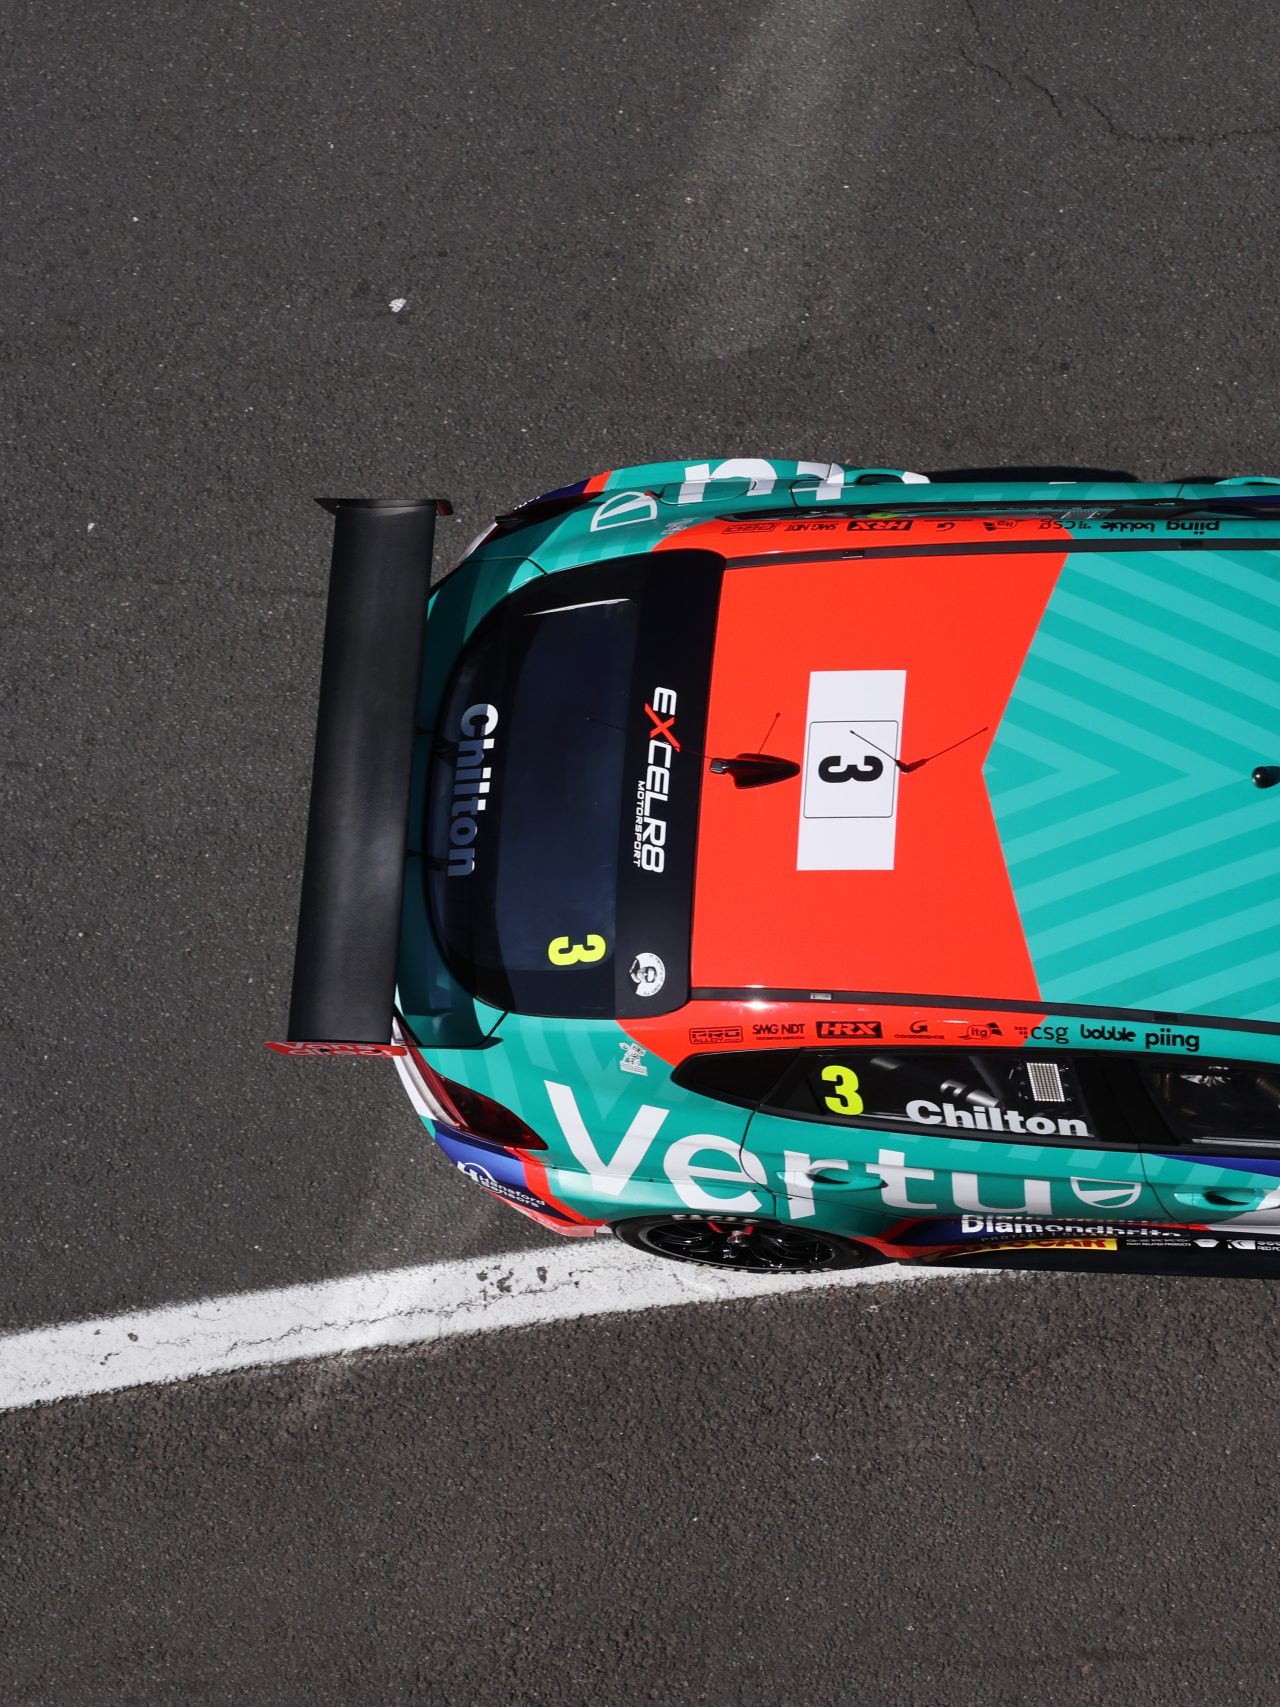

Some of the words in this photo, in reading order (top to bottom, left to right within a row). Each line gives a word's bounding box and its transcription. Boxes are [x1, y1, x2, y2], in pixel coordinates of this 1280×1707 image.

[1166, 520, 1220, 535] piing
[641, 686, 681, 873] EXCELR8
[817, 754, 884, 784] 3
[448, 703, 499, 877] Chilton
[632, 780, 646, 868] MOTORSPORT
[548, 934, 606, 966] 3
[752, 1023, 779, 1035] SMG
[781, 1023, 806, 1035] NDT
[820, 1022, 879, 1035] HRX
[970, 1027, 988, 1038] itg
[1031, 1026, 1069, 1045] csg
[1080, 1024, 1136, 1043] bobble
[1145, 1028, 1200, 1052] piing
[820, 1064, 865, 1116] 3
[904, 1098, 1089, 1138] Chilton
[543, 1079, 1053, 1220] Vertu
